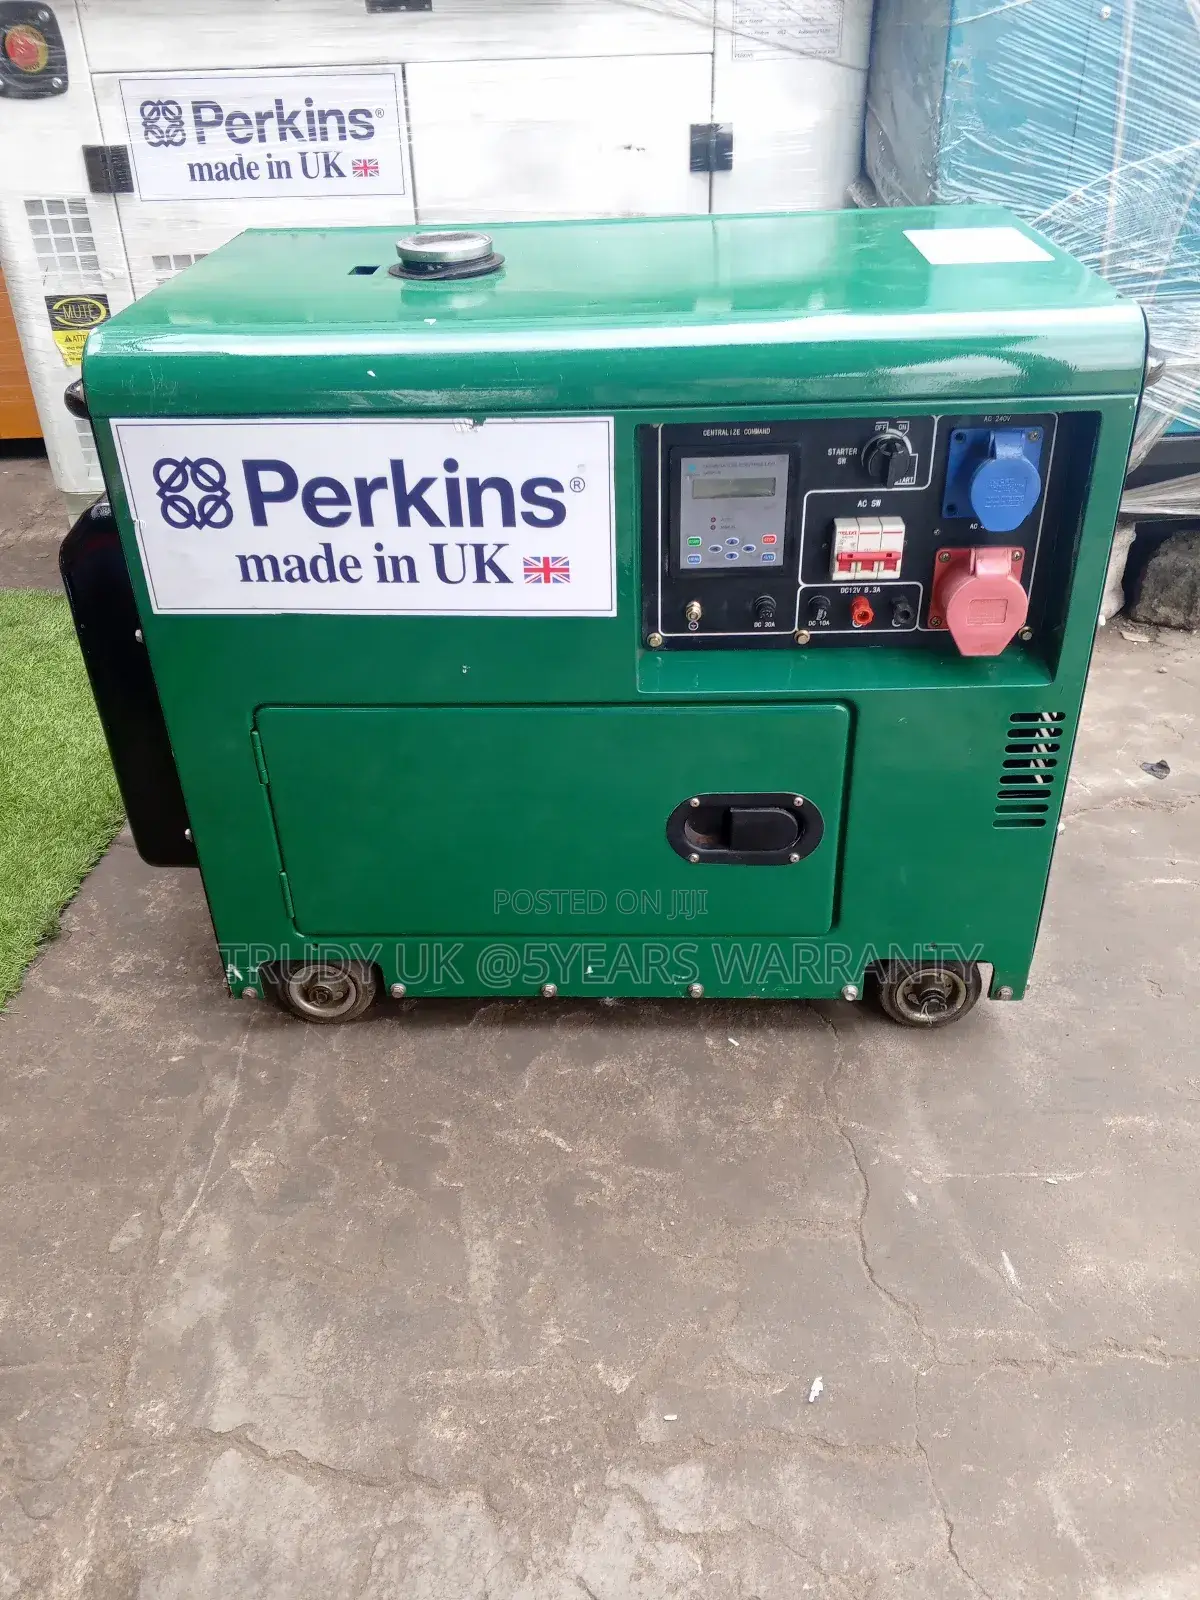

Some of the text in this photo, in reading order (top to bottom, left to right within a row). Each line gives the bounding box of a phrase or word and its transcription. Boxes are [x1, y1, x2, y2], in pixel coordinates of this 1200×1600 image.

[187, 151, 347, 182] made in UK
[62, 303, 97, 320] MUTE
[874, 423, 887, 432] OFF
[898, 423, 908, 431] ON
[702, 427, 771, 437] CENTRALIZE COMMAND
[827, 447, 858, 456] STARTER
[857, 499, 882, 508] AC SW
[235, 541, 514, 584] made in UK
[840, 586, 862, 595] DC12V
